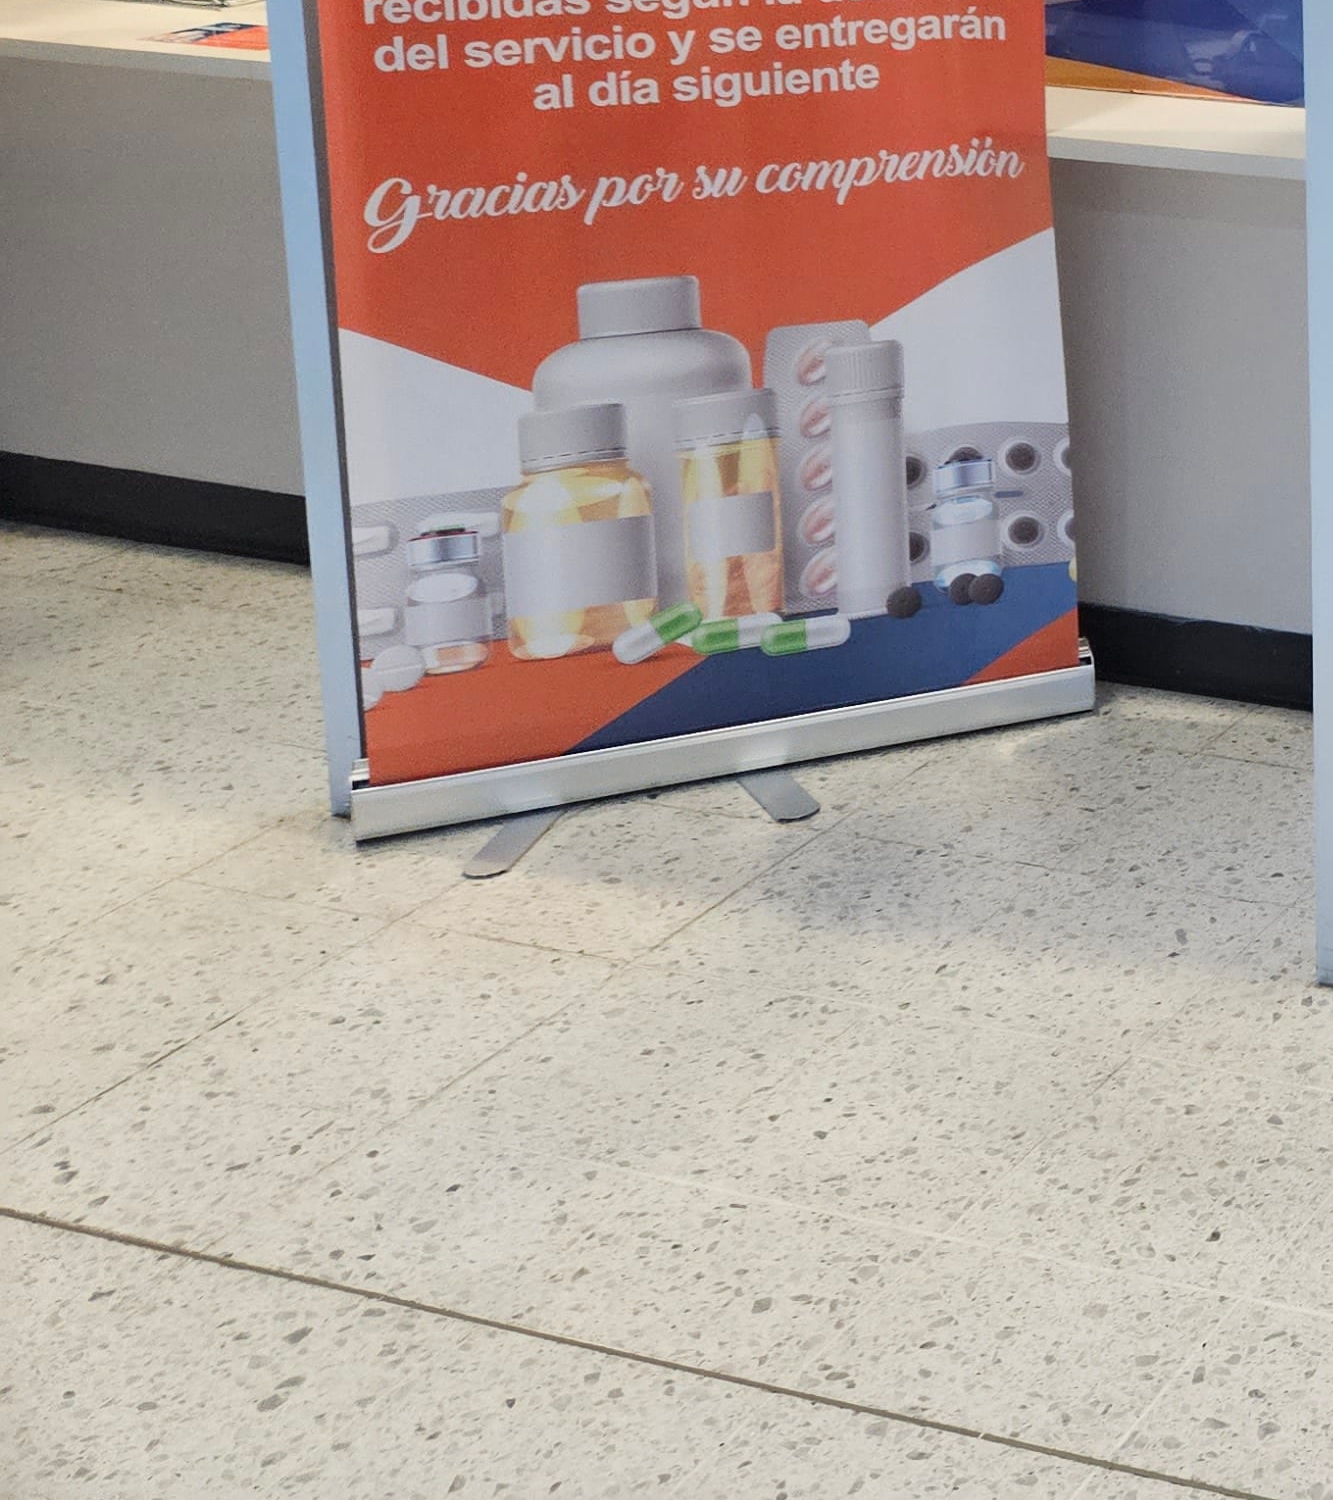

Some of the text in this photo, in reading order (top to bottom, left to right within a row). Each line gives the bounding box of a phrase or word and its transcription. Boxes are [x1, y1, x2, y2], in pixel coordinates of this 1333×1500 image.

[373, 8, 1006, 72] del servicio y se entregarán
[533, 60, 879, 112] al día siguiente
[364, 136, 1025, 255] Gracias por su comprensión
